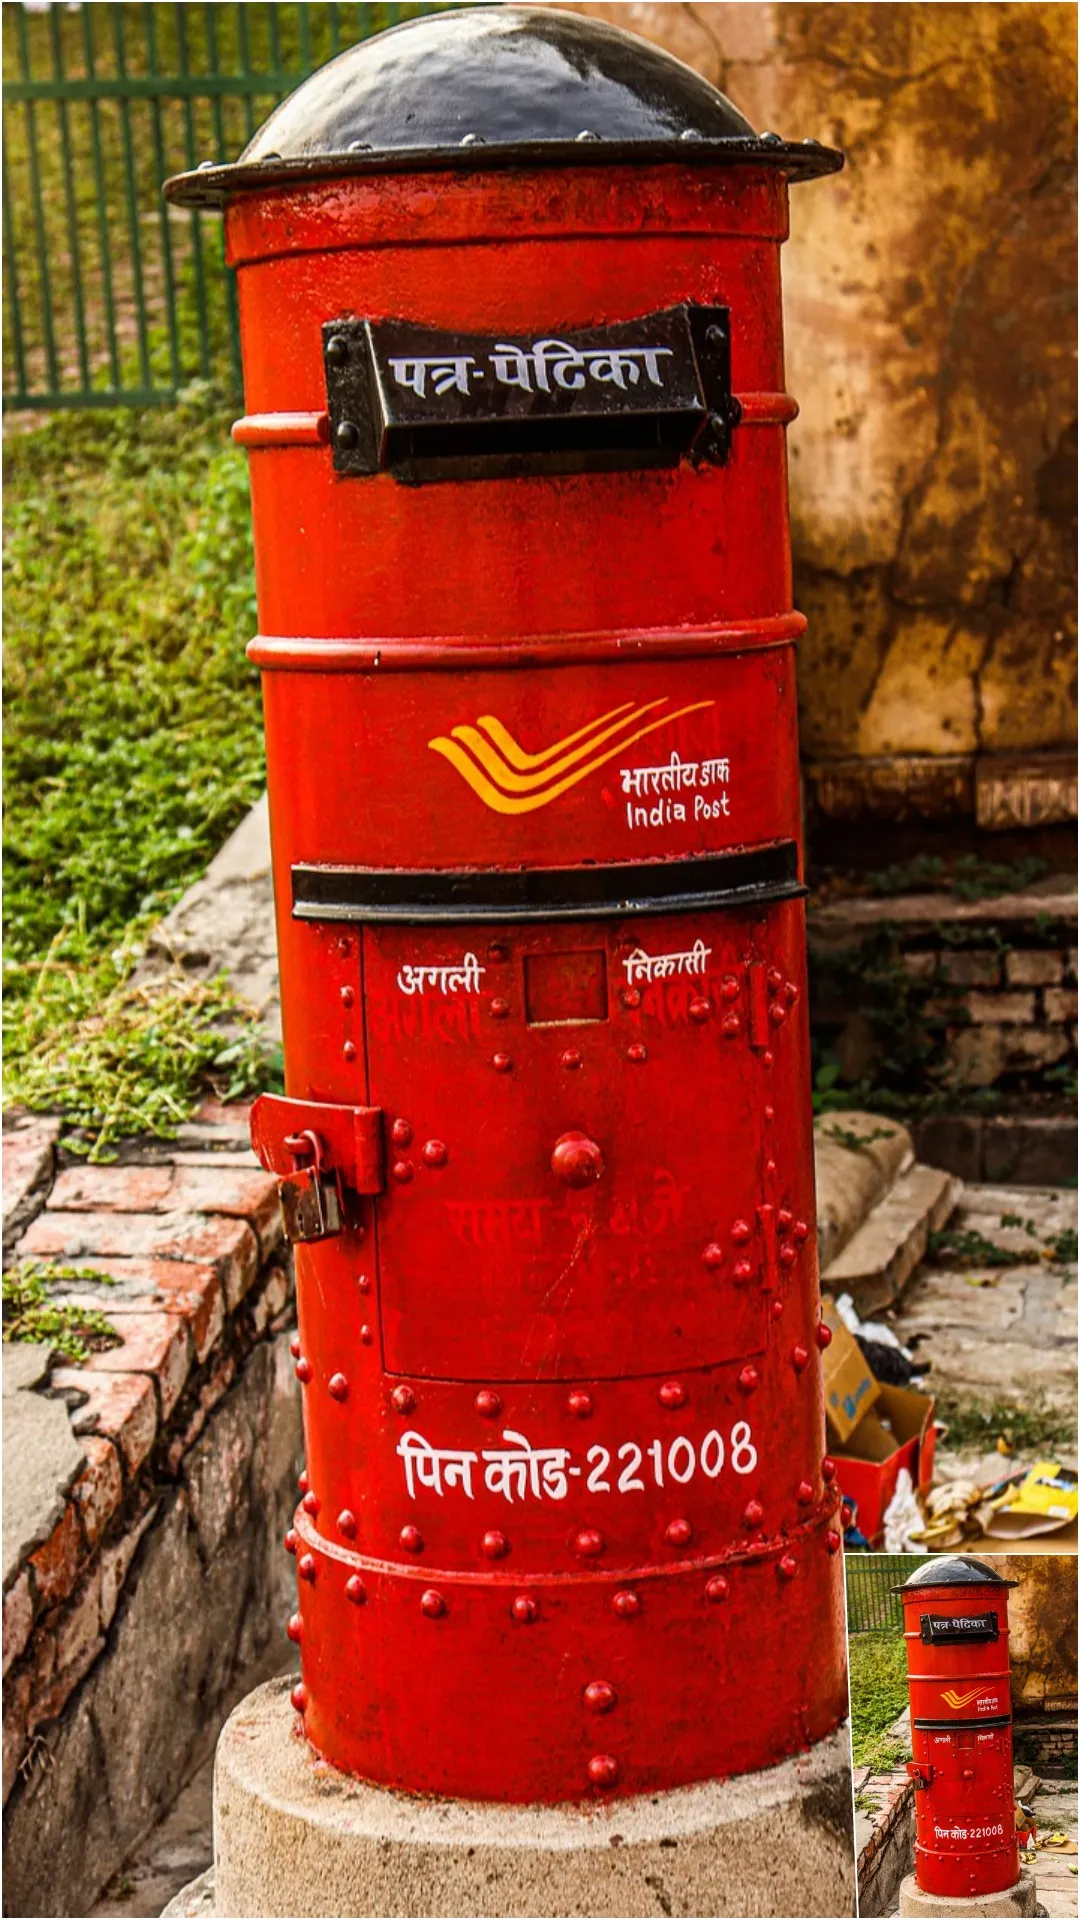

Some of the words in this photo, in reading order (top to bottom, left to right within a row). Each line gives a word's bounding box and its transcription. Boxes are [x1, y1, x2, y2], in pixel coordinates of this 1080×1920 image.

[388, 339, 674, 399] पत्र-पेटिका
[619, 750, 699, 798] भारतीय
[699, 757, 731, 788] डाक
[626, 797, 688, 830] India
[694, 790, 731, 821] Post
[396, 951, 487, 996] अगली
[396, 1430, 479, 1500] पिन
[481, 1420, 759, 1505] कोड-221008
[932, 1617, 987, 1630] पत्र-पेटिका
